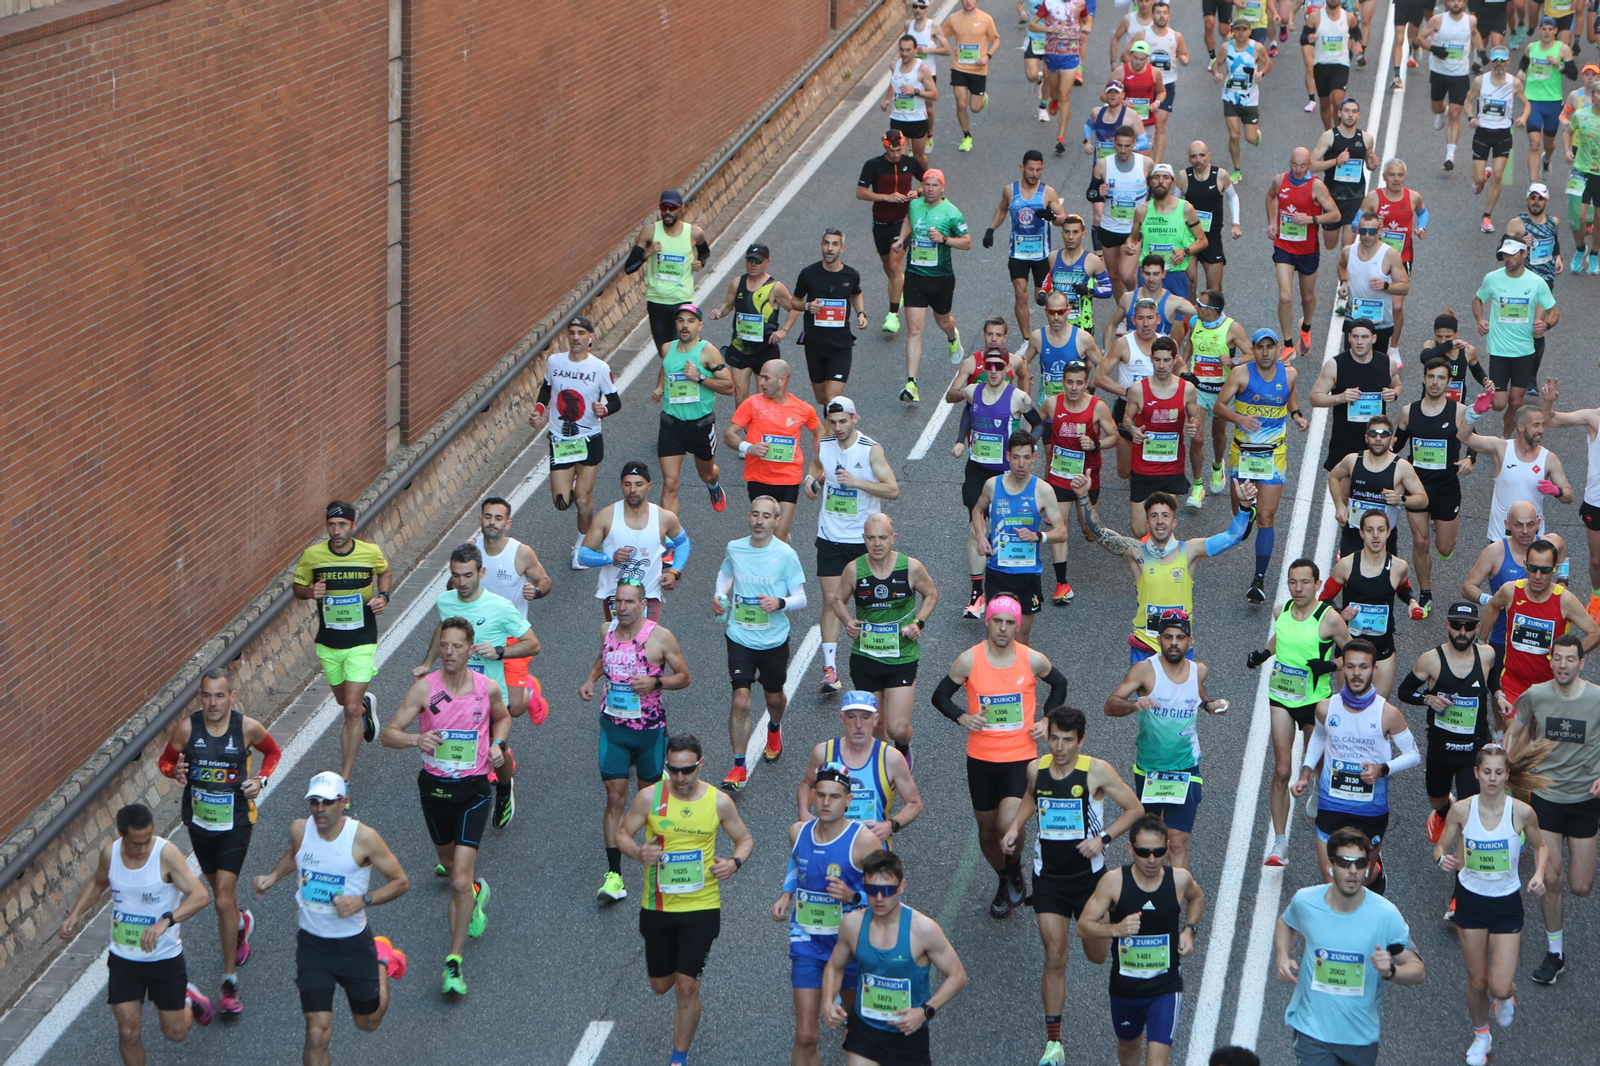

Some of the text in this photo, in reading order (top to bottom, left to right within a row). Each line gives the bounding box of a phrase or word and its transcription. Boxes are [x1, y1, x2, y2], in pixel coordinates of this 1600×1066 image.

[773, 437, 793, 445] ZURICH
[1061, 449, 1081, 458] ZURICH
[334, 597, 358, 605] ZURICH
[1527, 619, 1550, 629] ZURICH
[606, 652, 636, 664] PUTOS
[1282, 666, 1304, 676] ZURICH
[1280, 678, 1293, 686] 1571
[993, 695, 1017, 704] ZURICH
[1449, 710, 1463, 718] 1894
[1547, 730, 1584, 740] SAYSKY
[1341, 736, 1376, 745] CALIFATO
[1344, 776, 1360, 784] 3130
[202, 795, 227, 803] ZURICH
[674, 827, 697, 835] Unicaja
[1478, 842, 1504, 850] ZURICH
[671, 853, 698, 861] ZURICH
[1479, 855, 1494, 863] 1800
[1479, 863, 1496, 871] EMMA
[314, 873, 340, 883] ZURICH
[809, 896, 835, 904] ZURICH
[124, 916, 151, 925] ZURICH
[1135, 937, 1163, 946] ZURICH
[1136, 953, 1151, 961] 1481
[1330, 953, 1359, 962] ZURICH
[1329, 967, 1346, 976] 2002
[876, 980, 904, 989] ZURICH
[877, 994, 892, 1003] 1873
